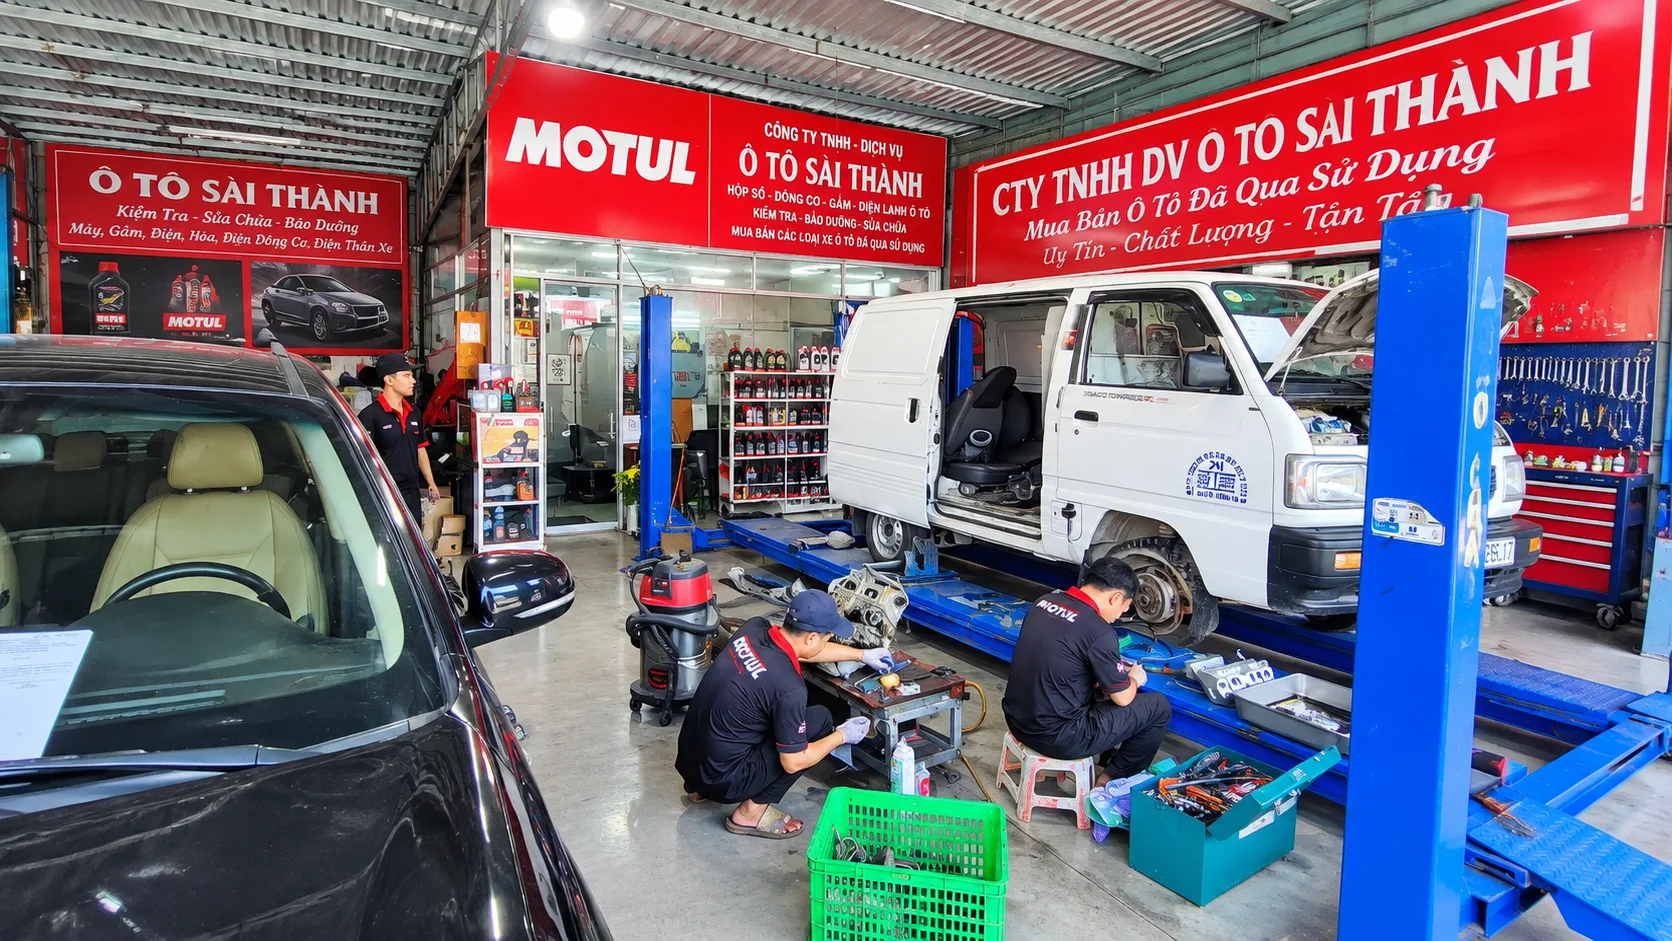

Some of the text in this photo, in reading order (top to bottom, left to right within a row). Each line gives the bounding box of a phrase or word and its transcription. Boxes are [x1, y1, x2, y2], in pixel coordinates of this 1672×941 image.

[764, 120, 799, 142] CÔNG
[801, 129, 817, 145] TY
[820, 132, 851, 150] TNHH
[860, 139, 887, 158] DỊCH
[889, 143, 903, 162] VỤ
[993, 174, 1045, 216] CTY
[1052, 152, 1133, 205] TNHH
[1141, 139, 1190, 187] DV
[1365, 30, 1593, 138] THÀNH
[505, 117, 696, 185] MOTUL
[739, 143, 923, 199] Ô TÔ SÀI THÀNH
[89, 165, 378, 215] Ô TÔ SÀI THÀNH
[1024, 218, 1071, 242] Mua
[1127, 196, 1146, 223] Ô
[1187, 185, 1228, 212] Đã
[1307, 157, 1359, 192] Sử
[1364, 137, 1496, 182] Dụng
[162, 208, 189, 222] Tra
[779, 210, 798, 223] TRA
[345, 239, 375, 252] Thân
[377, 242, 393, 254] Xe
[731, 225, 753, 238] MUA
[777, 228, 797, 242] CÁC
[799, 232, 820, 247] LOẠI
[822, 234, 833, 245] XE
[870, 239, 888, 251] QUA
[1043, 246, 1068, 269] Uy
[1073, 240, 1106, 261] Tín
[1124, 226, 1182, 253] Chất
[167, 316, 223, 328] MOTUL
